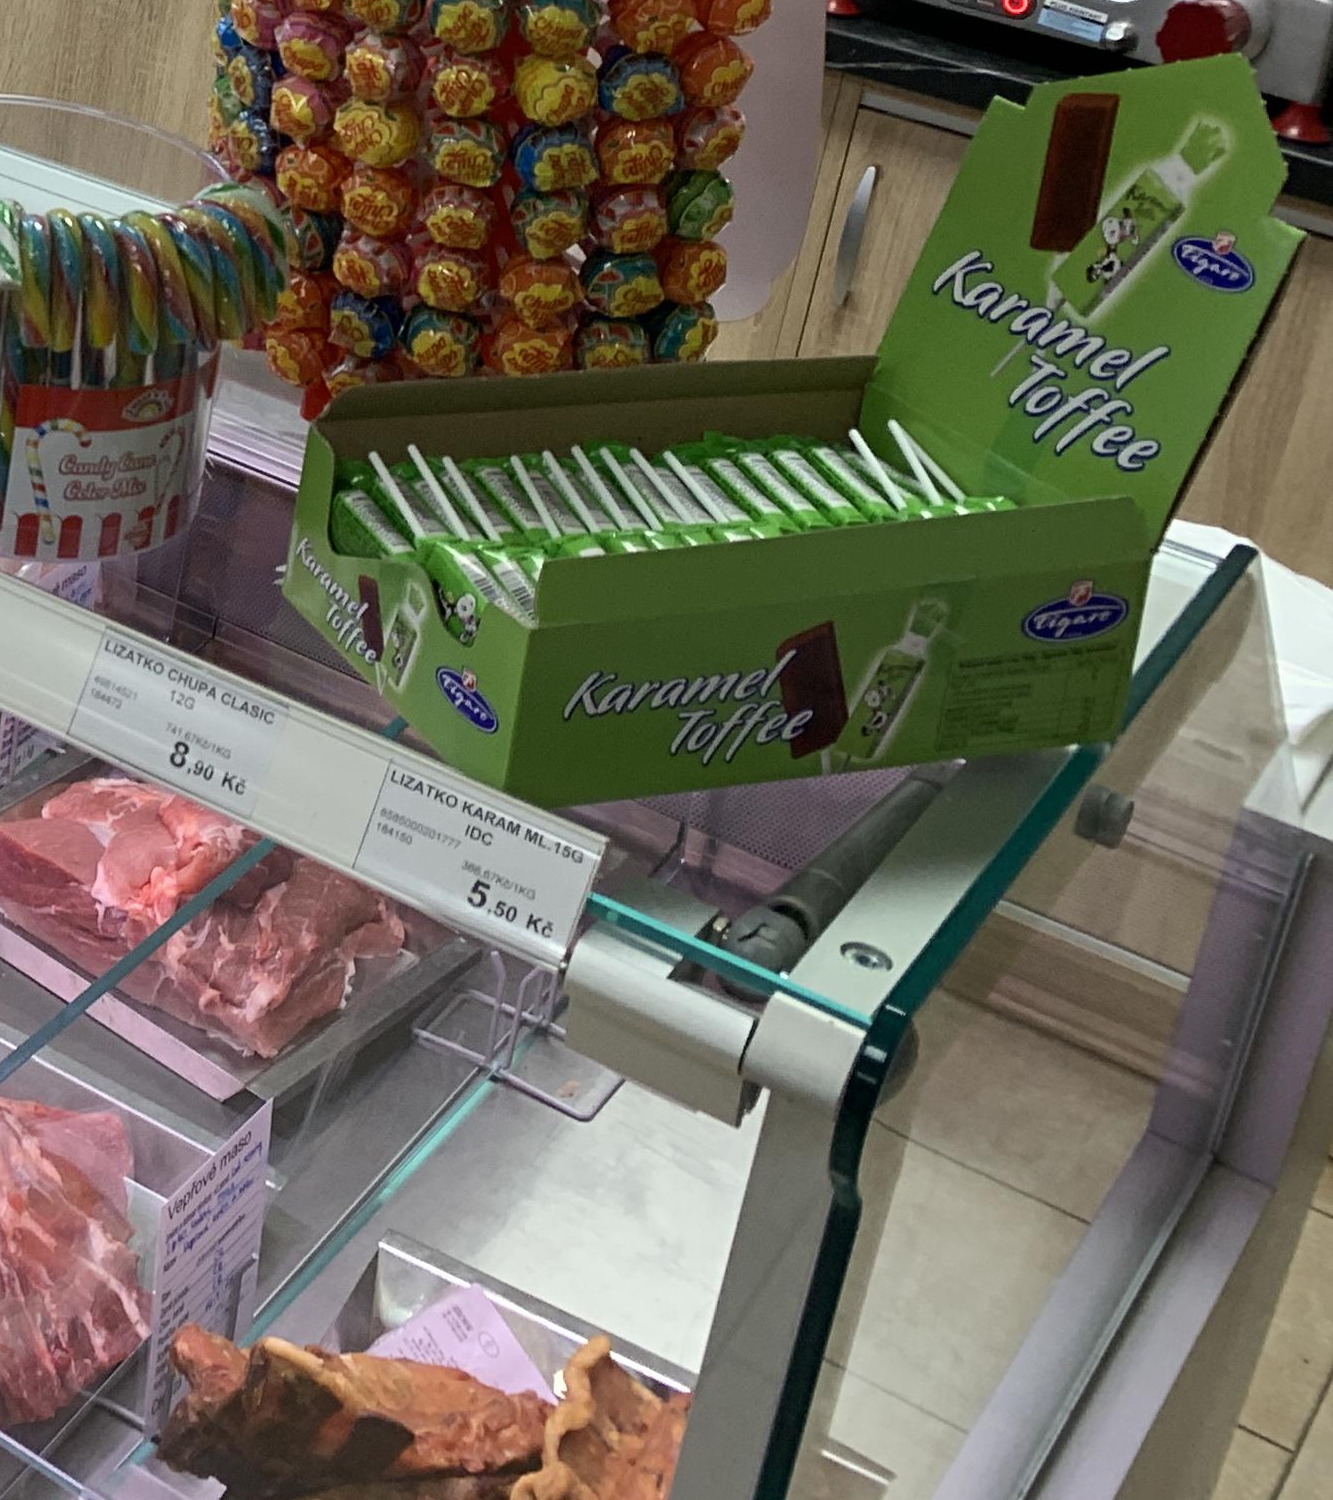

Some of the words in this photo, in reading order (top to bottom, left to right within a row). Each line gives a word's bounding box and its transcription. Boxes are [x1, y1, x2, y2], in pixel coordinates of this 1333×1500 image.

[932, 250, 1171, 390] Karamel
[1009, 355, 1161, 471] Toffee
[59, 453, 120, 478] Candy
[64, 481, 114, 500] Color
[295, 537, 369, 619] Karamel
[325, 602, 378, 665] Toffee
[104, 640, 166, 677] LIZATKO
[167, 668, 218, 700] CHUPA
[222, 693, 275, 726] CLASIC
[169, 689, 196, 711] 12G
[563, 649, 797, 721] Karamel
[670, 701, 814, 766] Toffee
[222, 771, 247, 797] Kč
[390, 769, 459, 810] LIZATKO
[462, 800, 523, 836] KARAM
[523, 828, 585, 865] ML.15G
[464, 824, 494, 847] IDC
[527, 911, 554, 941] Kč
[167, 1162, 218, 1217] Vepřové
[219, 1131, 253, 1169] maso
